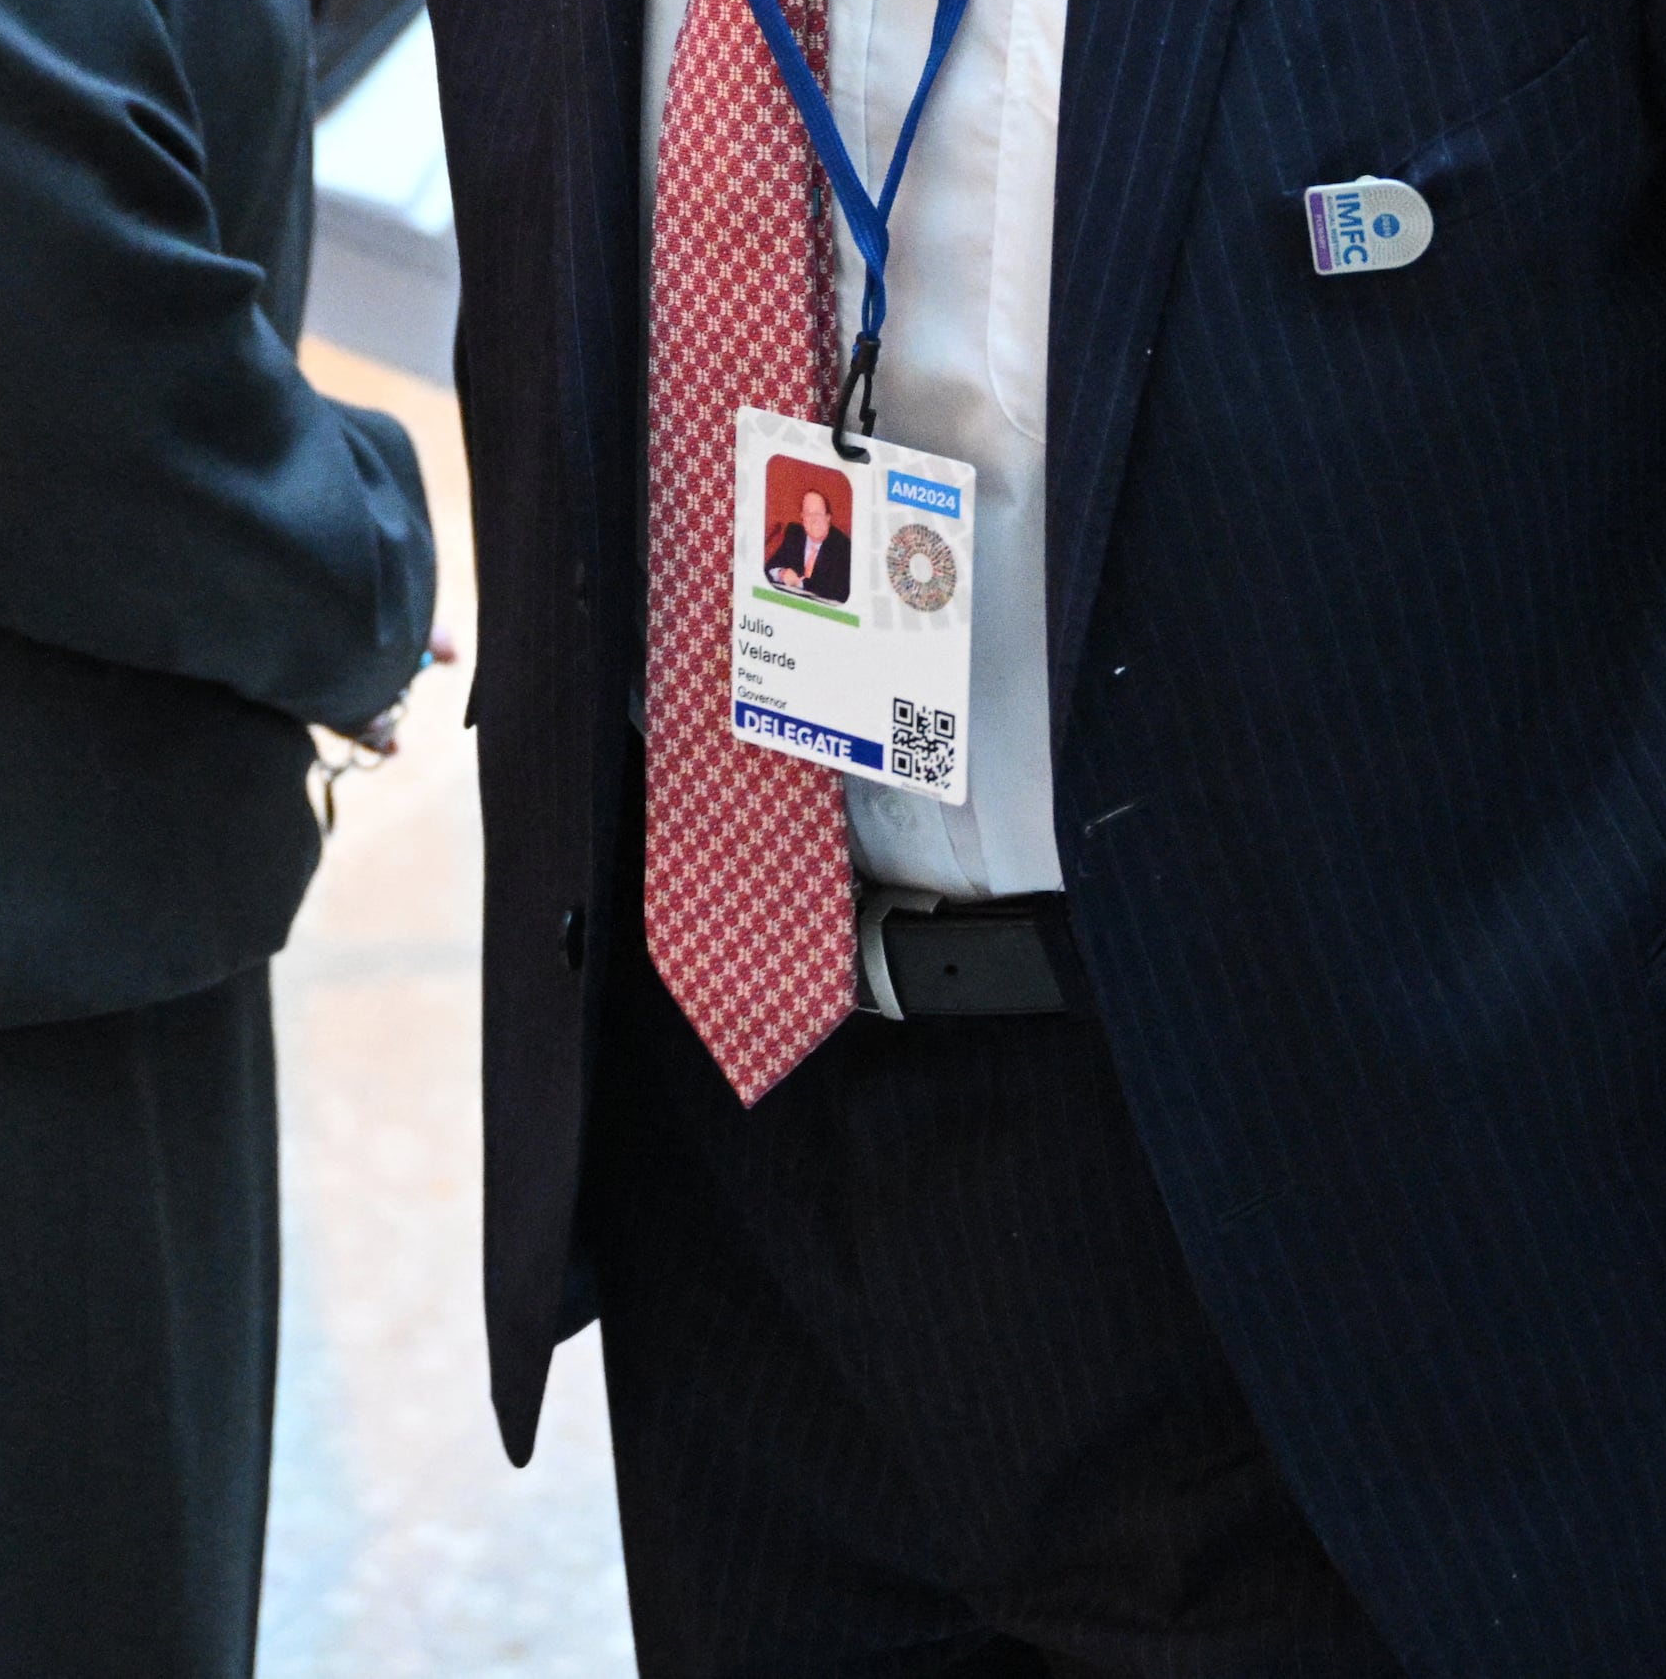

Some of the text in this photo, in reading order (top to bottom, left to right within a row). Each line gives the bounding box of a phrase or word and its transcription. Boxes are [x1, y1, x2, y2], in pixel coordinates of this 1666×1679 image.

[1335, 192, 1368, 264] IMFC
[891, 480, 956, 511] AM2024
[738, 614, 774, 638] Julio
[738, 638, 796, 671] Velarde
[737, 667, 763, 685] Peru
[737, 685, 787, 710] Governor
[743, 709, 853, 759] DELEGATE
